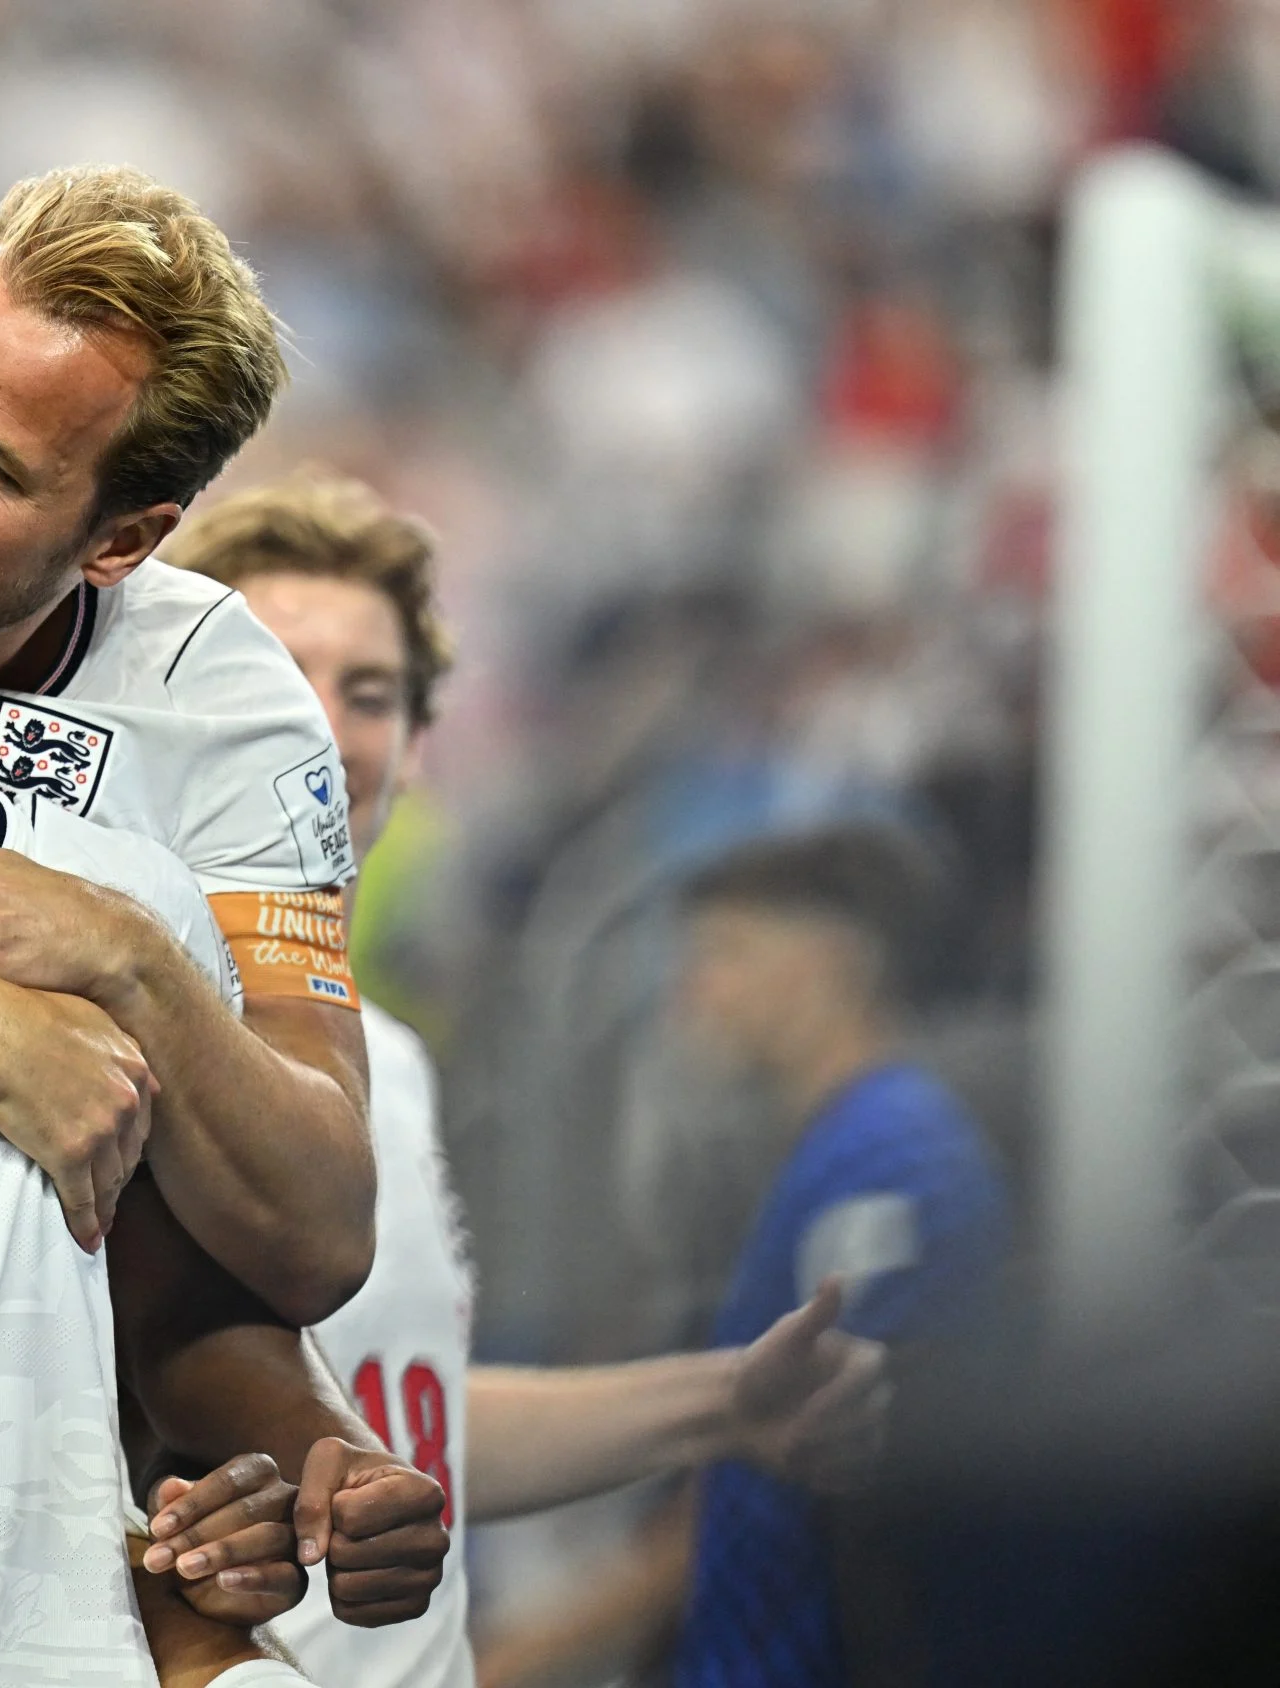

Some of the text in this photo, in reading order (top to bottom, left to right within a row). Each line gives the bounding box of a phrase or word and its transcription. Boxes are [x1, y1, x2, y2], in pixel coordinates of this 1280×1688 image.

[257, 906, 344, 951] UNITES
[247, 939, 307, 966] the
[312, 978, 347, 998] FIFA
[353, 1356, 454, 1530] 18
